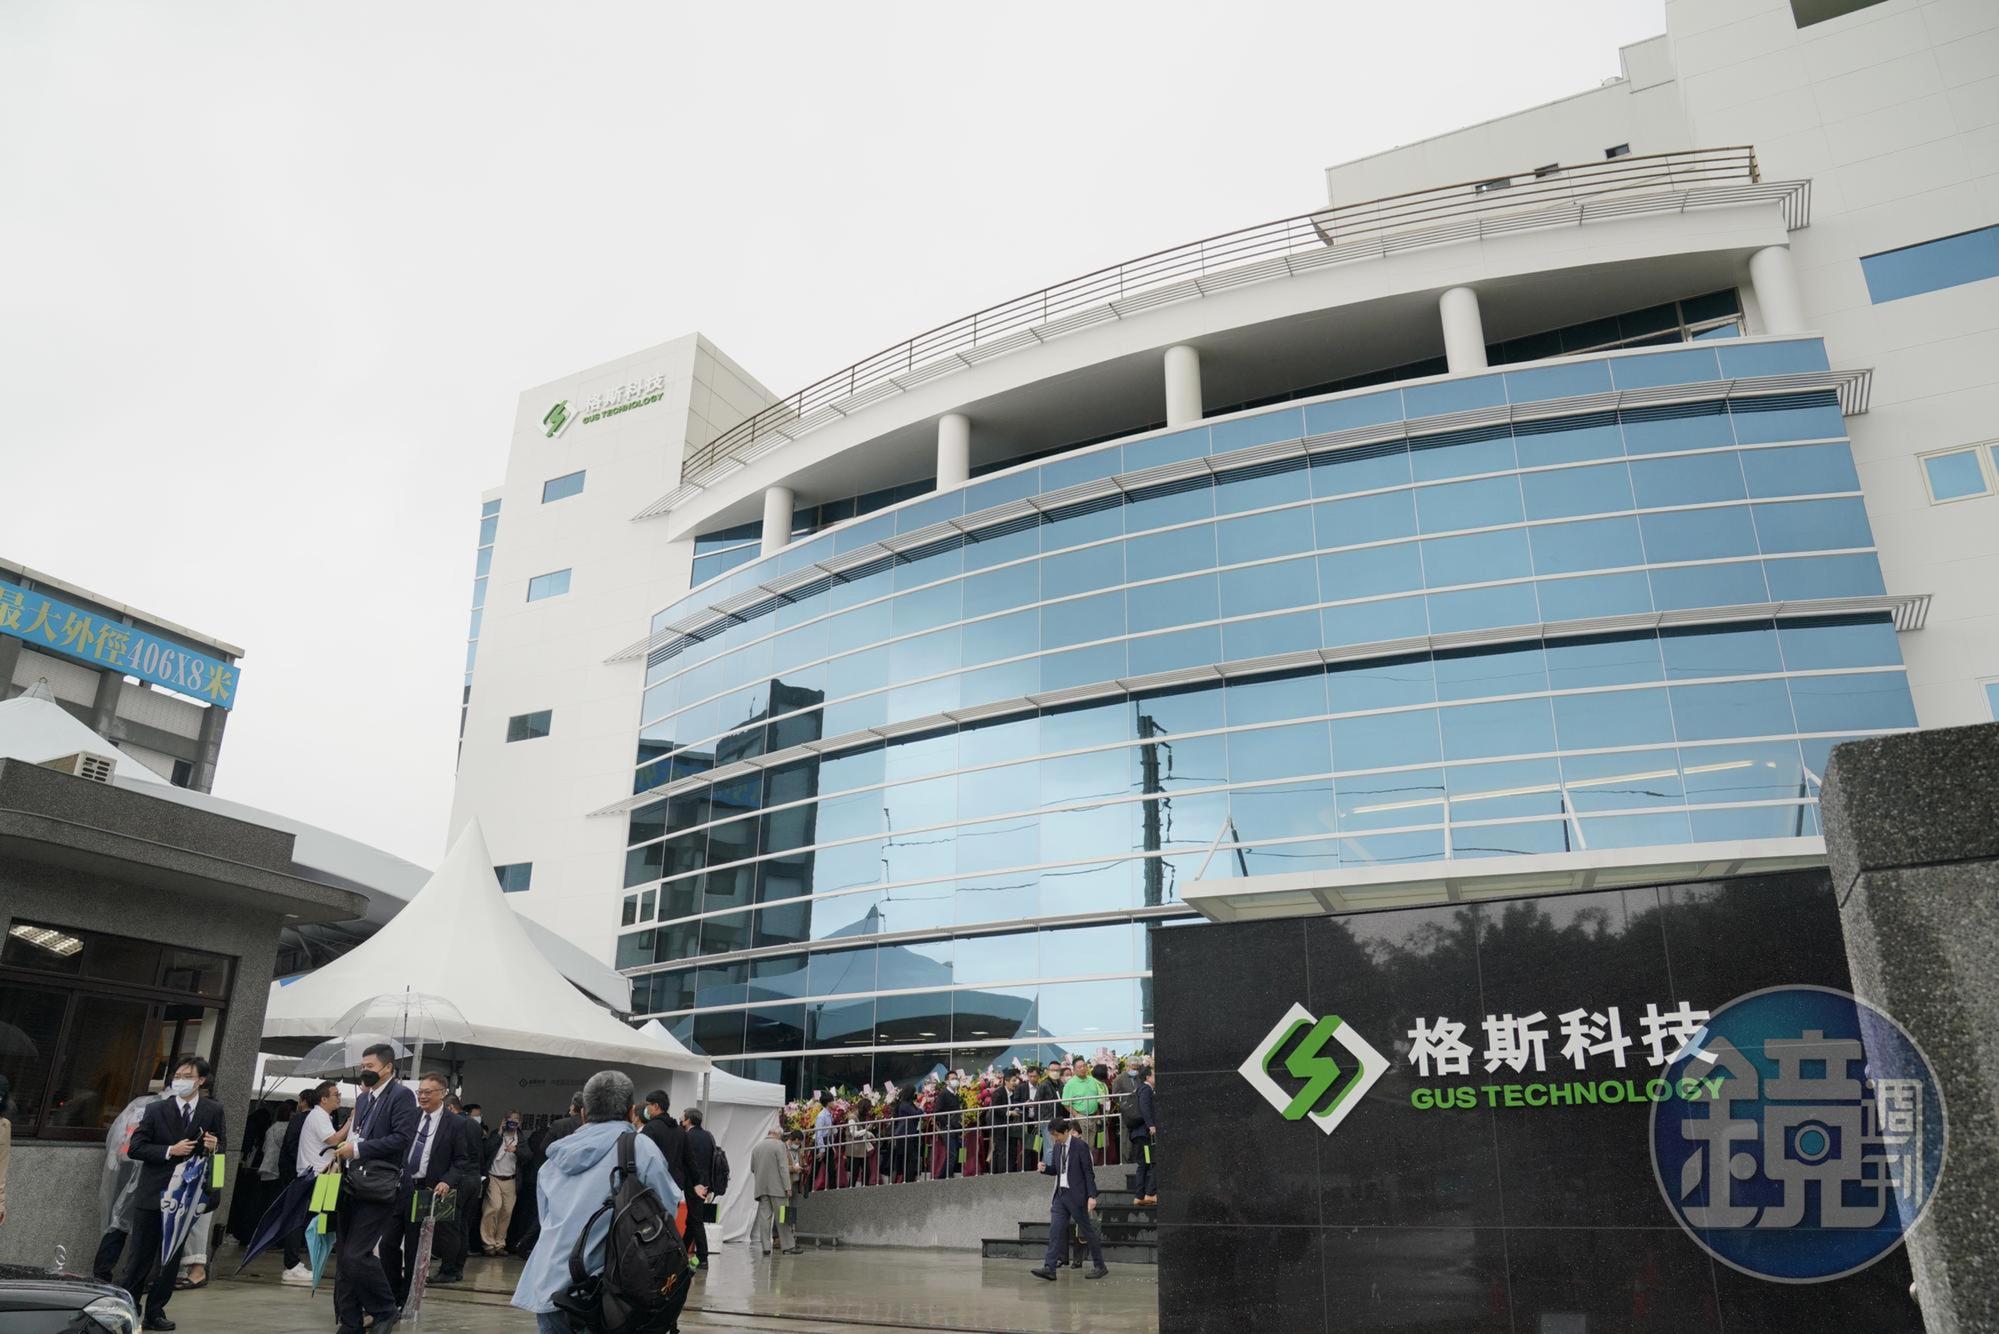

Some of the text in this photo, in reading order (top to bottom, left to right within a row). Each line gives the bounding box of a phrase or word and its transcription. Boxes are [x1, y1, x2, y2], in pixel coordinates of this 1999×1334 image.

[582, 392, 664, 425] GUS TECHNOLOGY
[1407, 1001, 1719, 1077] 格斯科技
[1410, 1076, 1726, 1110] GUS TECHNOLOGY
